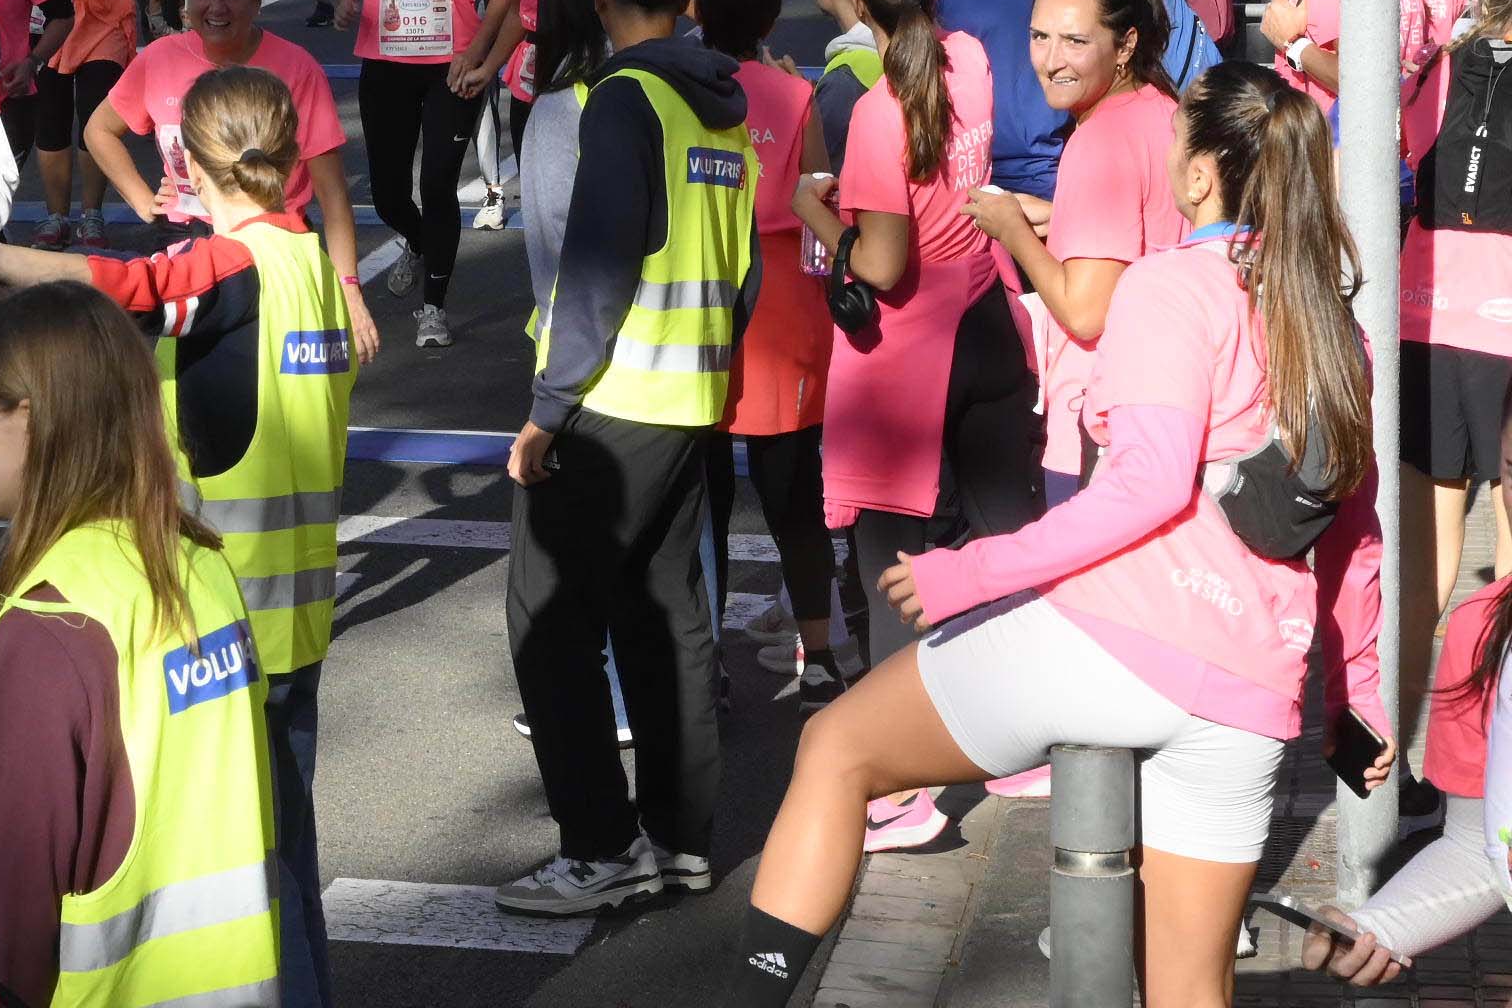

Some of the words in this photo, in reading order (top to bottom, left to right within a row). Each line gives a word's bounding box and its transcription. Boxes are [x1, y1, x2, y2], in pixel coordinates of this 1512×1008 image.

[402, 16, 428, 26] 016
[946, 119, 994, 161] CARRER
[958, 149, 977, 173] DE
[1464, 145, 1483, 193] EVADICT
[1170, 568, 1244, 616] OYSHO
[748, 955, 789, 980] adidas
